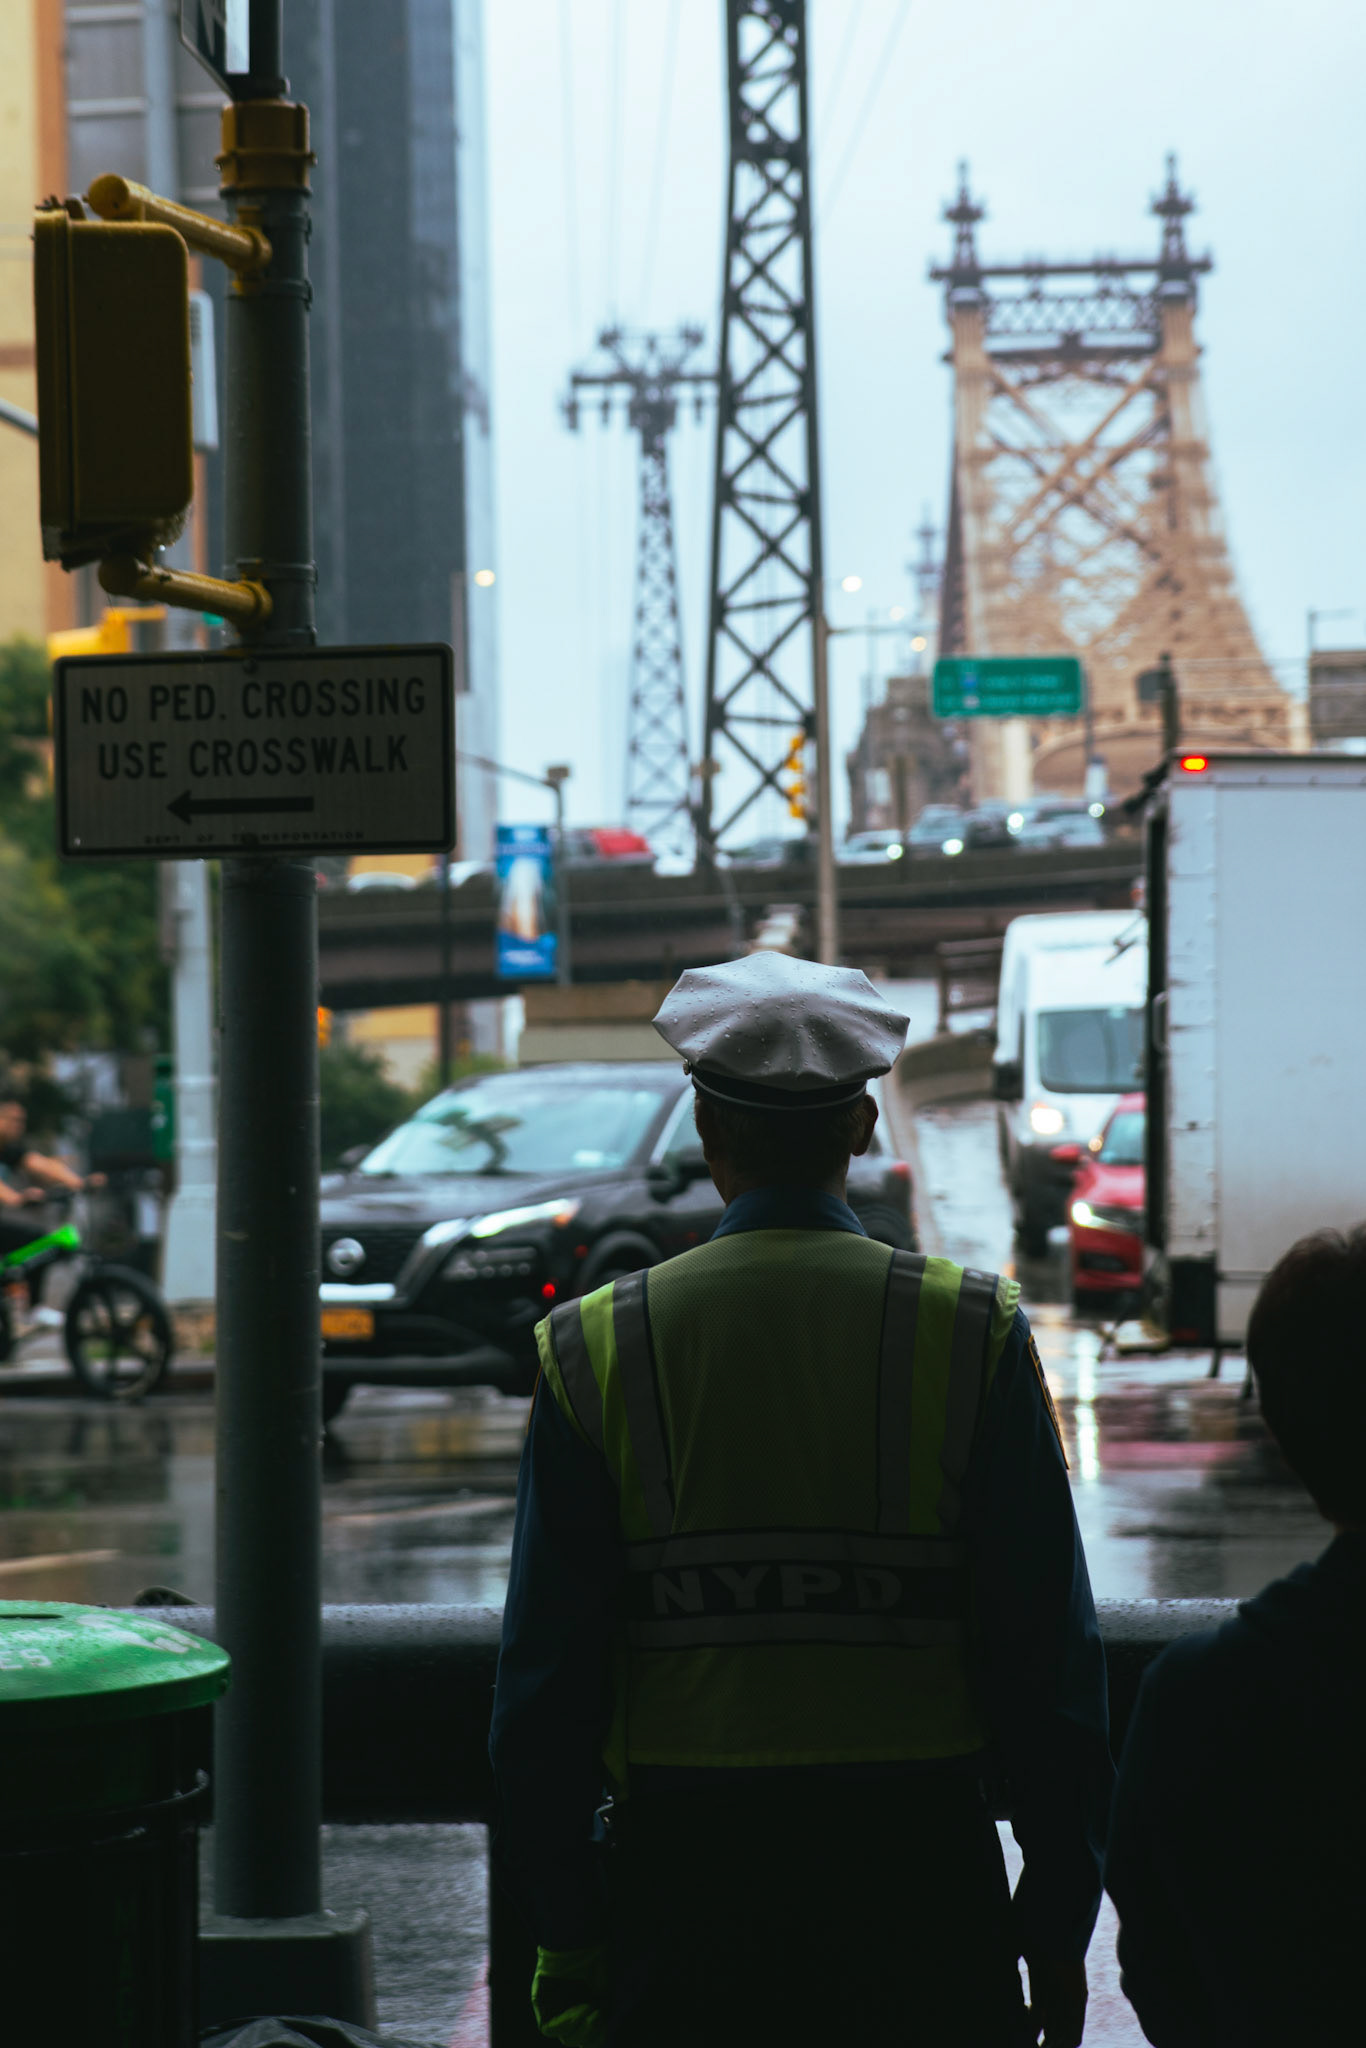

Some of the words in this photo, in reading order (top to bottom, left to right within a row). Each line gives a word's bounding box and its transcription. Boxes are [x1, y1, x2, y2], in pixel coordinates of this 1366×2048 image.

[81, 685, 129, 724] NO
[150, 683, 227, 722] PED.
[241, 677, 426, 720] CROSSING
[98, 741, 168, 780] USE
[189, 734, 409, 778] CROSSWALK
[231, 831, 365, 842] TNSPORTATION
[652, 1564, 903, 1614] NYPD
